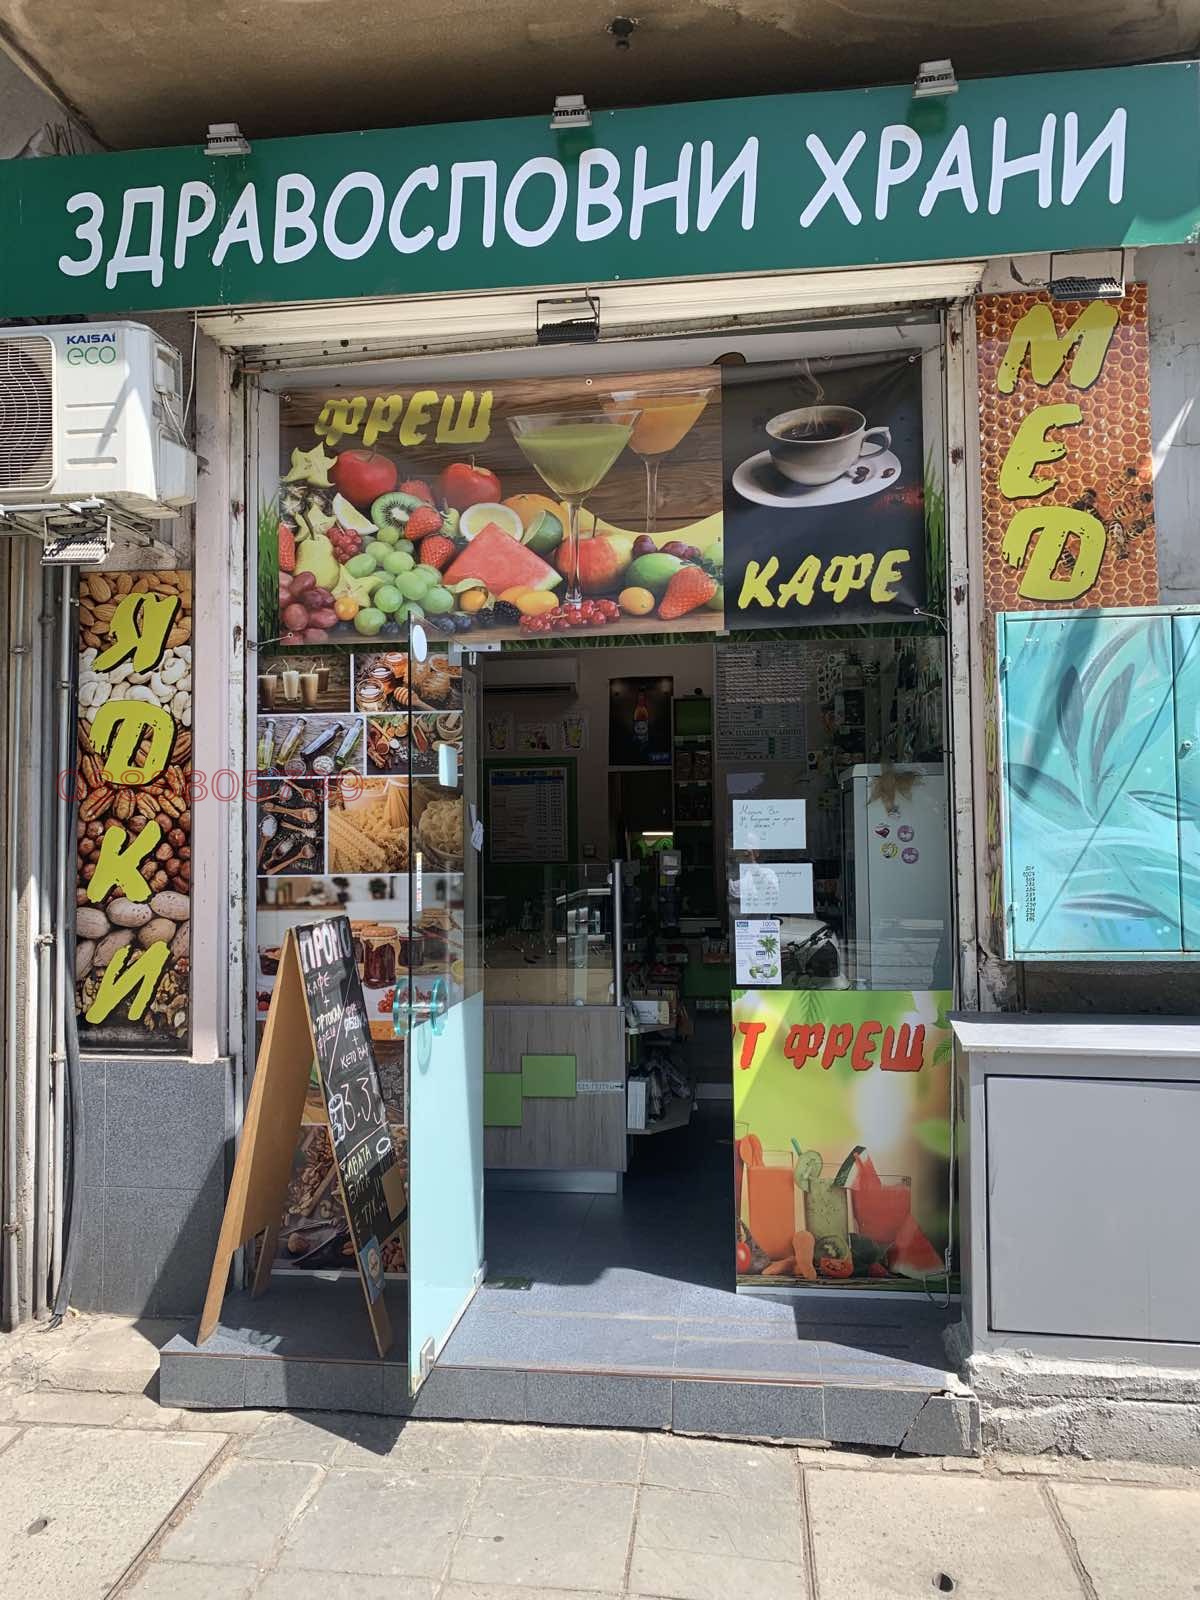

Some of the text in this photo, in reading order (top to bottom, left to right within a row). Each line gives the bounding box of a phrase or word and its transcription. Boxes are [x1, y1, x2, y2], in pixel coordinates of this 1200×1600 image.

[58, 107, 1127, 289] ЗДРАВОСЛОВНИ ХРАНИ
[66, 332, 116, 345] KAISAI
[67, 346, 117, 366] eco
[314, 389, 494, 447] ФРЕШ
[996, 300, 1119, 602] МЕД
[737, 548, 911, 610] КАФЕ
[84, 592, 181, 1025] ЯДКИ
[299, 919, 353, 973] ПРОМО
[306, 971, 330, 998] КАФЕ
[732, 1020, 926, 1072] Т ФРЕШ
